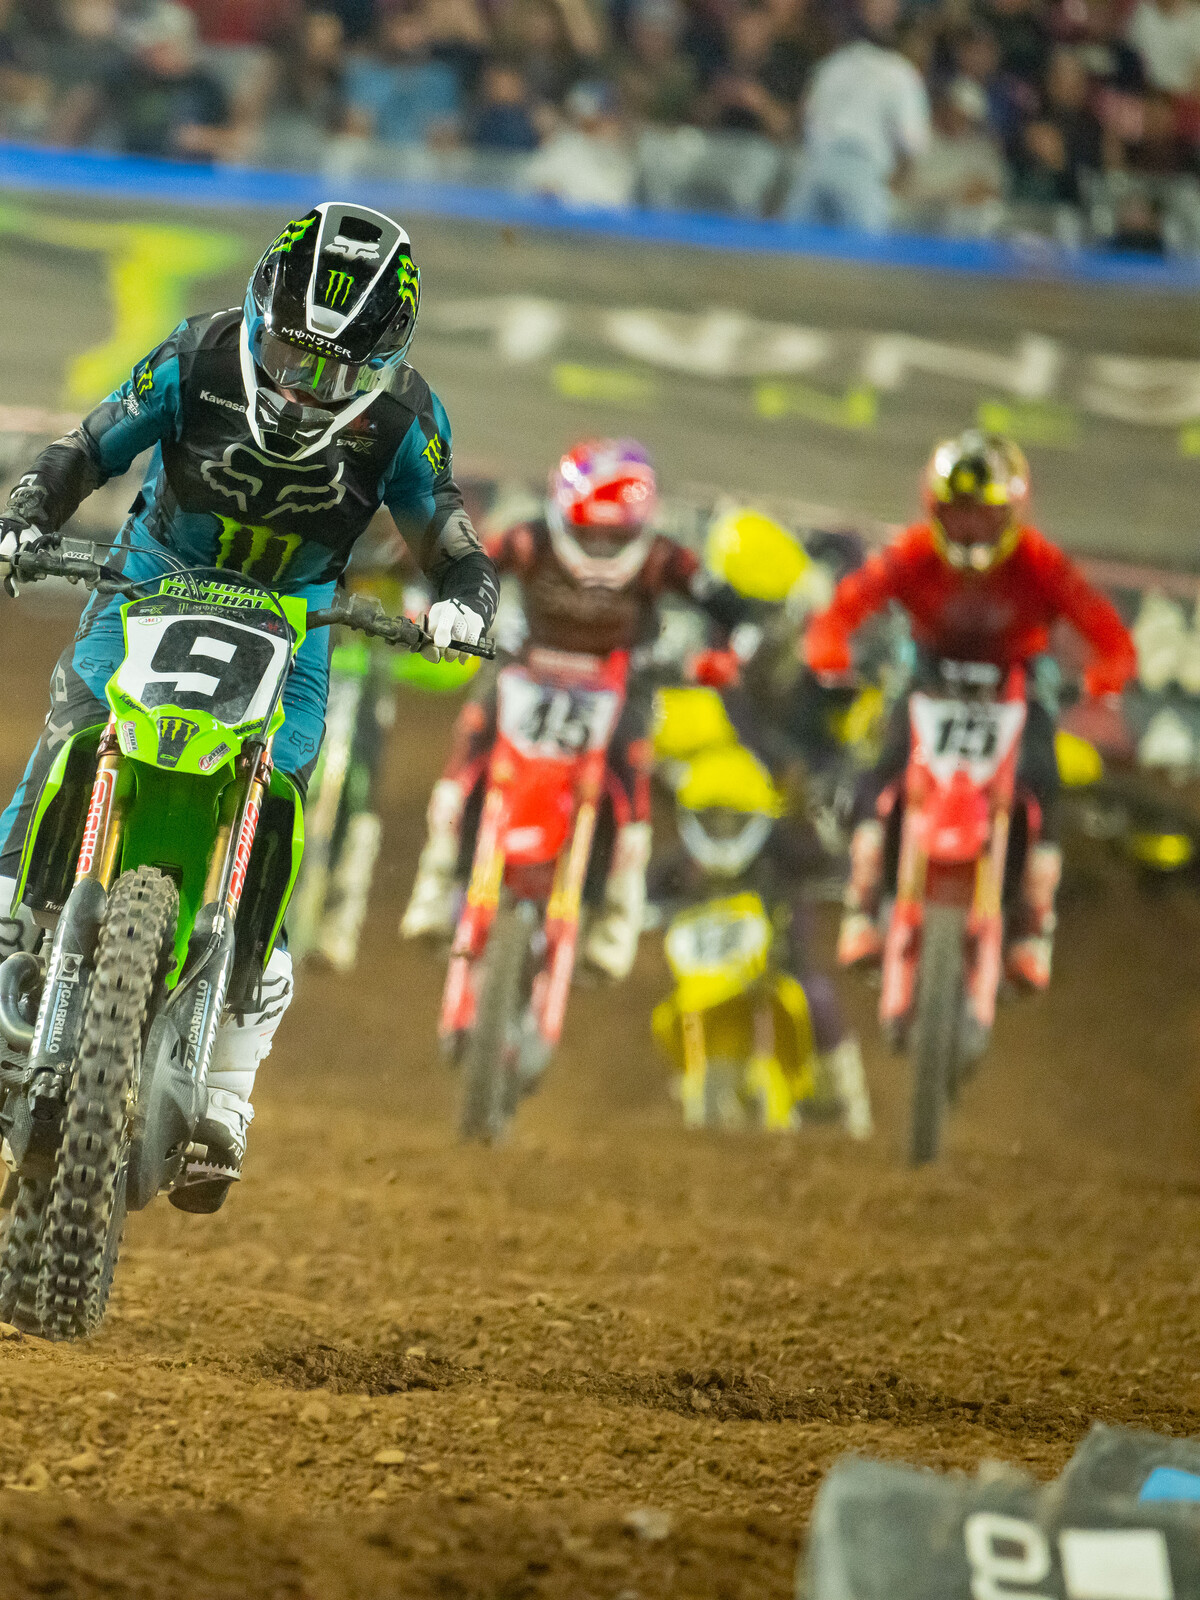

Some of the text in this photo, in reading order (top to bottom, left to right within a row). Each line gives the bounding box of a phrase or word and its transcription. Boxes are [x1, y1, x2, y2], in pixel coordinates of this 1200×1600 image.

[281, 327, 351, 358] MONSTER
[200, 390, 246, 413] Kawasa
[140, 620, 275, 725] 9
[49, 988, 73, 1054] CARRILLO
[188, 979, 209, 1044] CARRILLO
